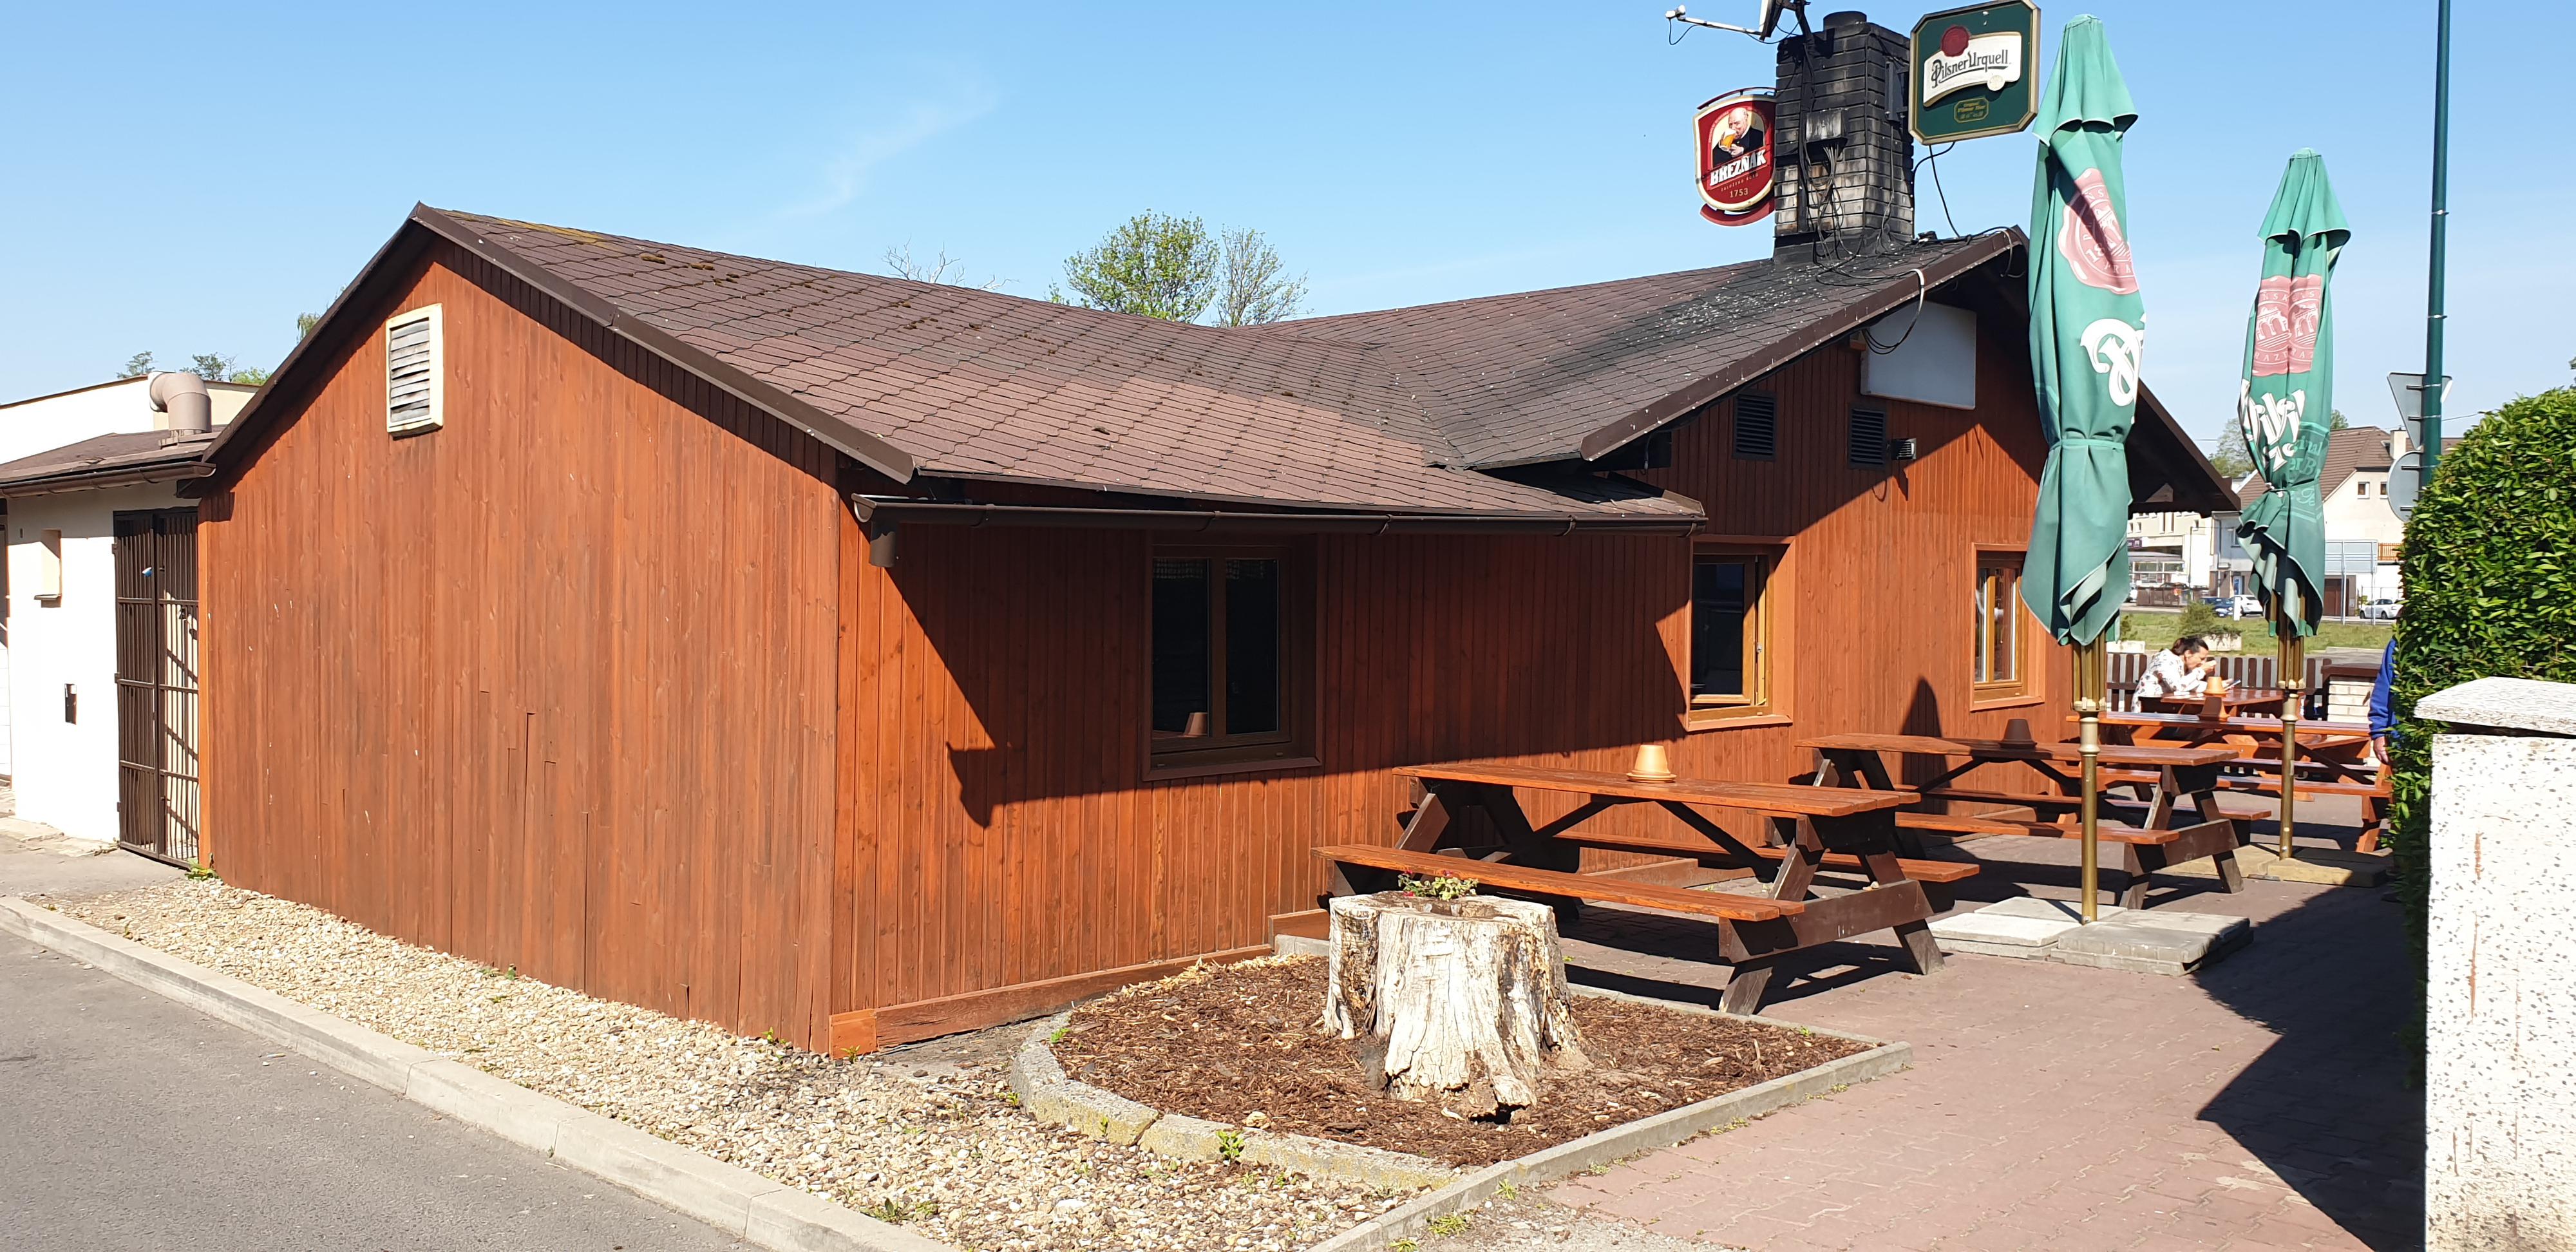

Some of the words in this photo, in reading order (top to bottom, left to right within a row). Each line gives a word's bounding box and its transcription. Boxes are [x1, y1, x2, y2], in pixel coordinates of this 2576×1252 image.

[1931, 59, 1968, 89] Pilsner
[1967, 49, 2008, 73] Urquell
[1729, 187, 1748, 198] 1753
